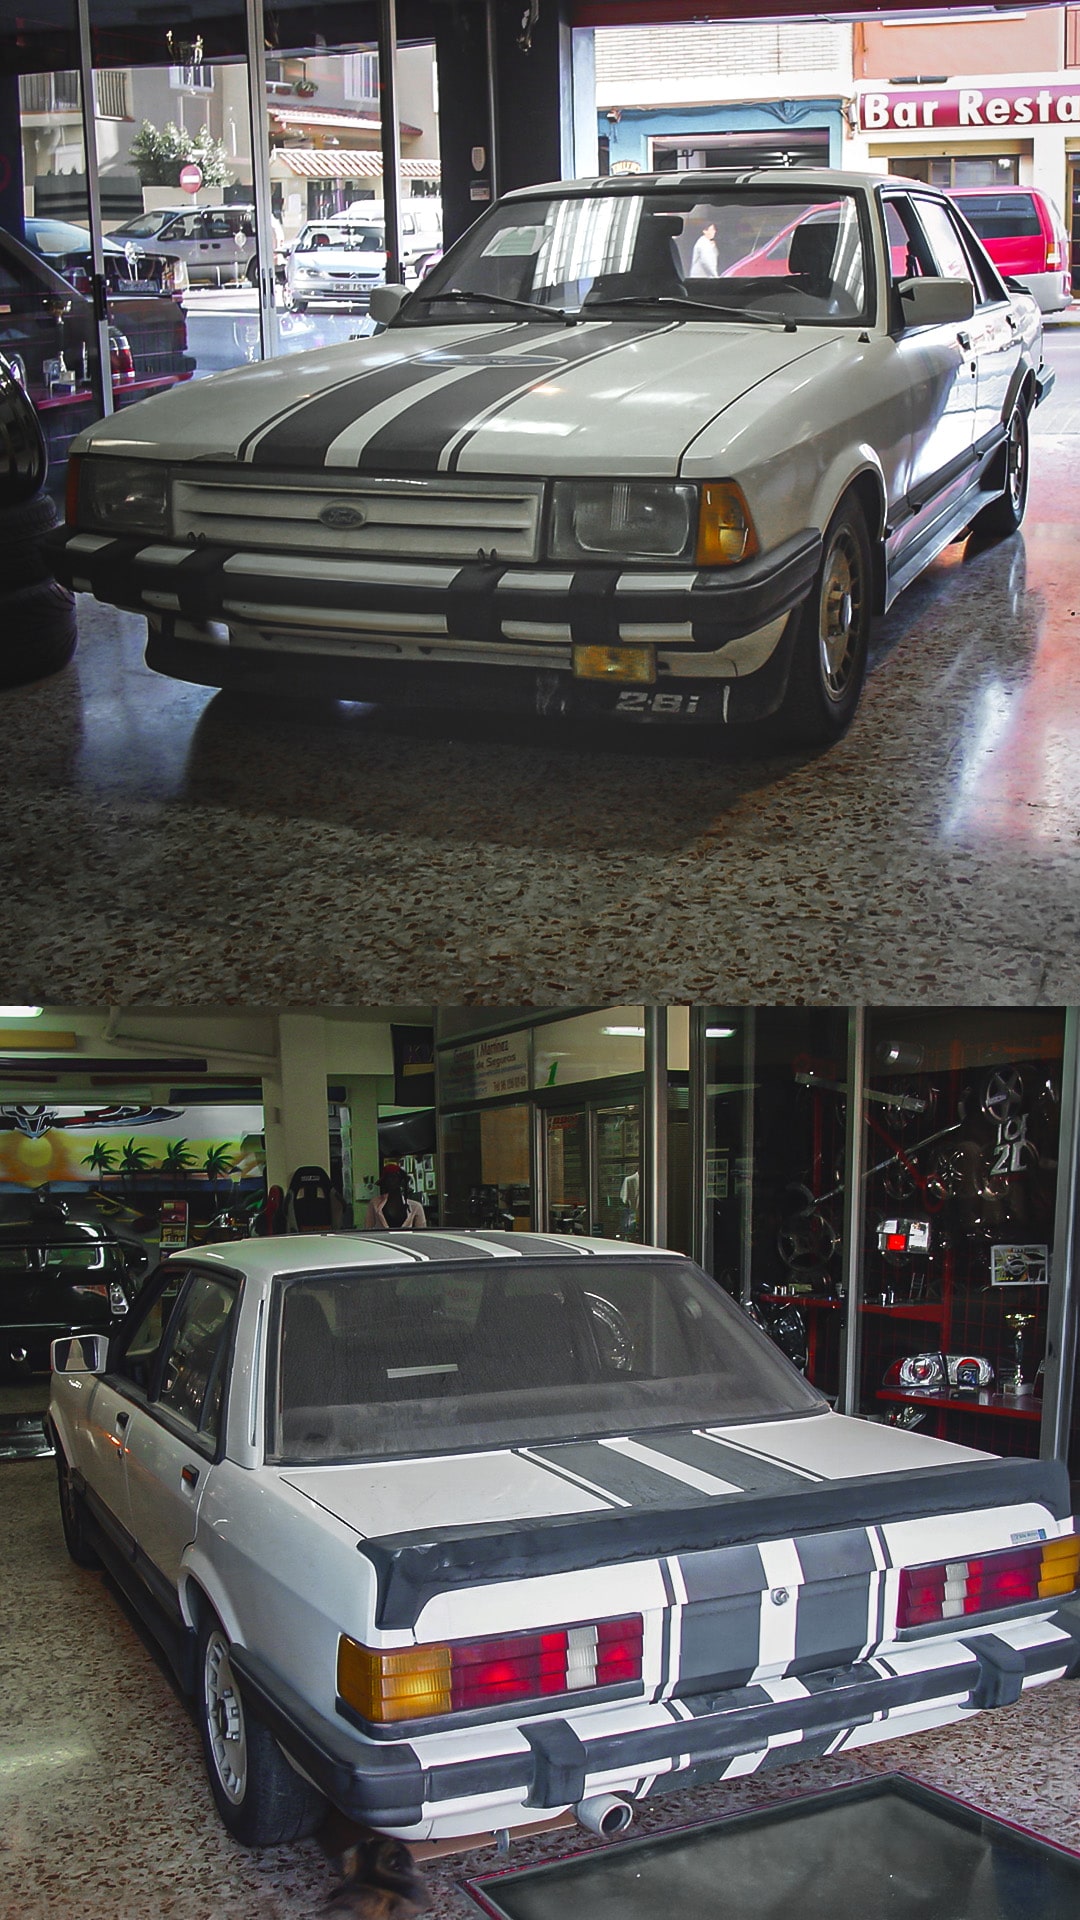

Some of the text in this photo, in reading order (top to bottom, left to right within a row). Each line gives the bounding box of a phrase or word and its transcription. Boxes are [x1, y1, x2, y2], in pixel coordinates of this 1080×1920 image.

[864, 89, 1080, 129] Bar Resta
[328, 509, 357, 522] Ford
[545, 1061, 559, 1086] 1
